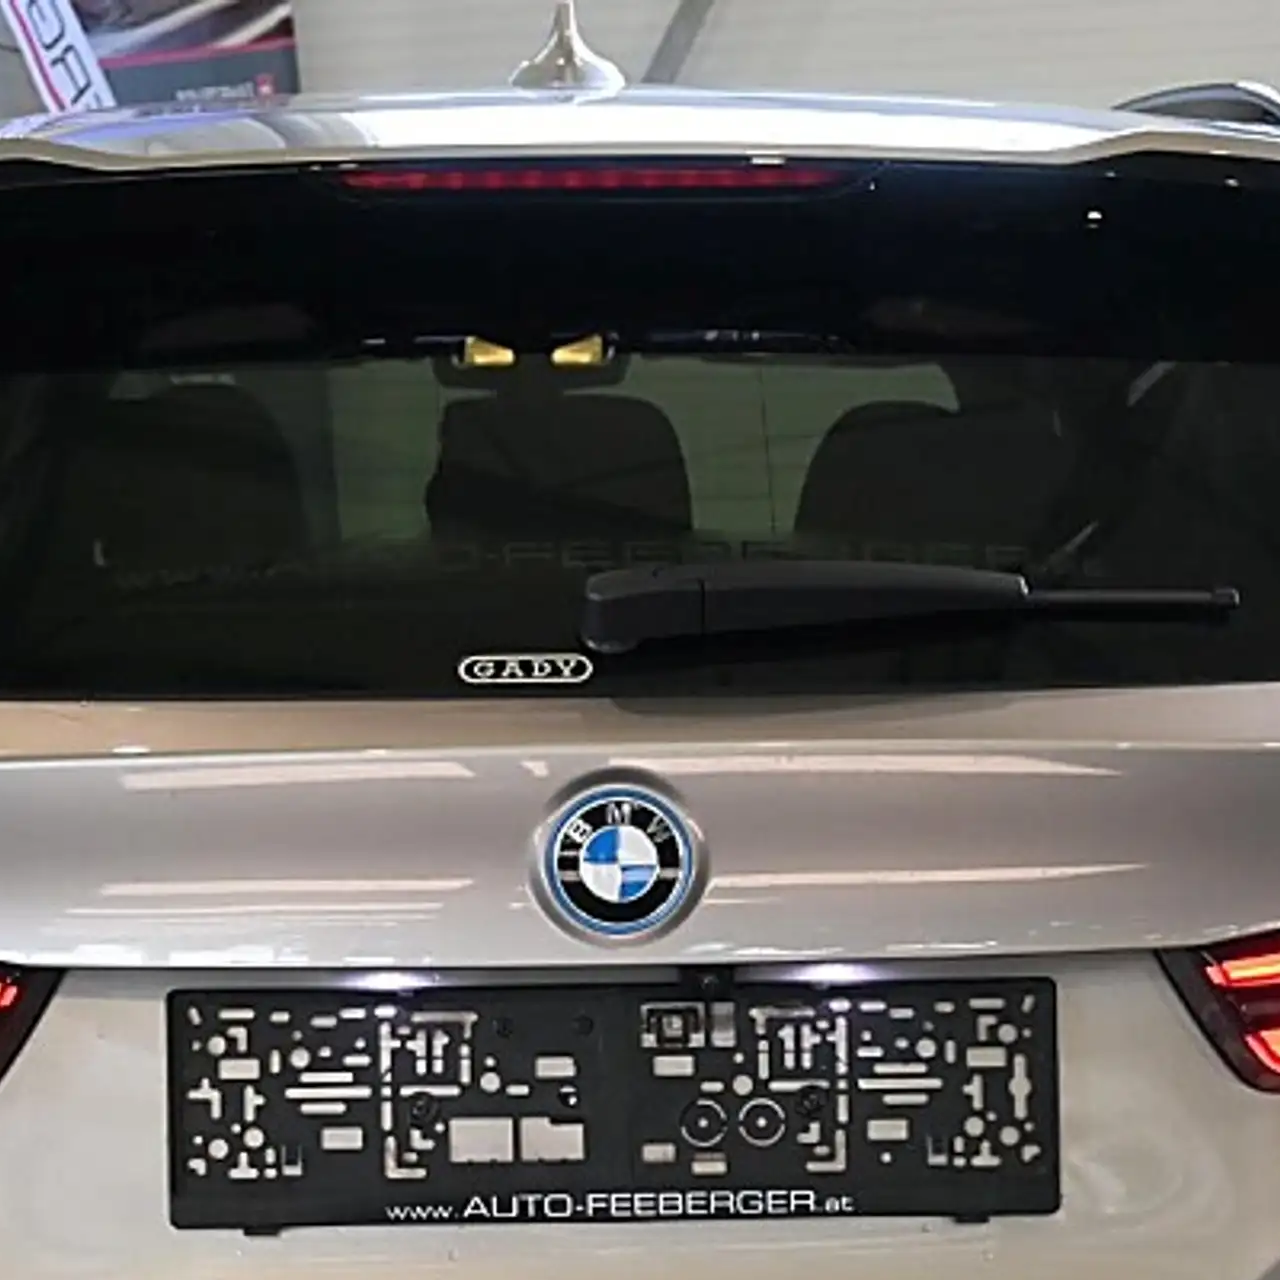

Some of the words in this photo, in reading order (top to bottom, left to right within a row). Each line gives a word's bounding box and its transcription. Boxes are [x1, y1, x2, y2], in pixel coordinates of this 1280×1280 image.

[472, 658, 578, 678] GADY
[566, 802, 672, 843] BMW
[384, 1189, 855, 1220] www.AUTO-FEEBERGER.at
